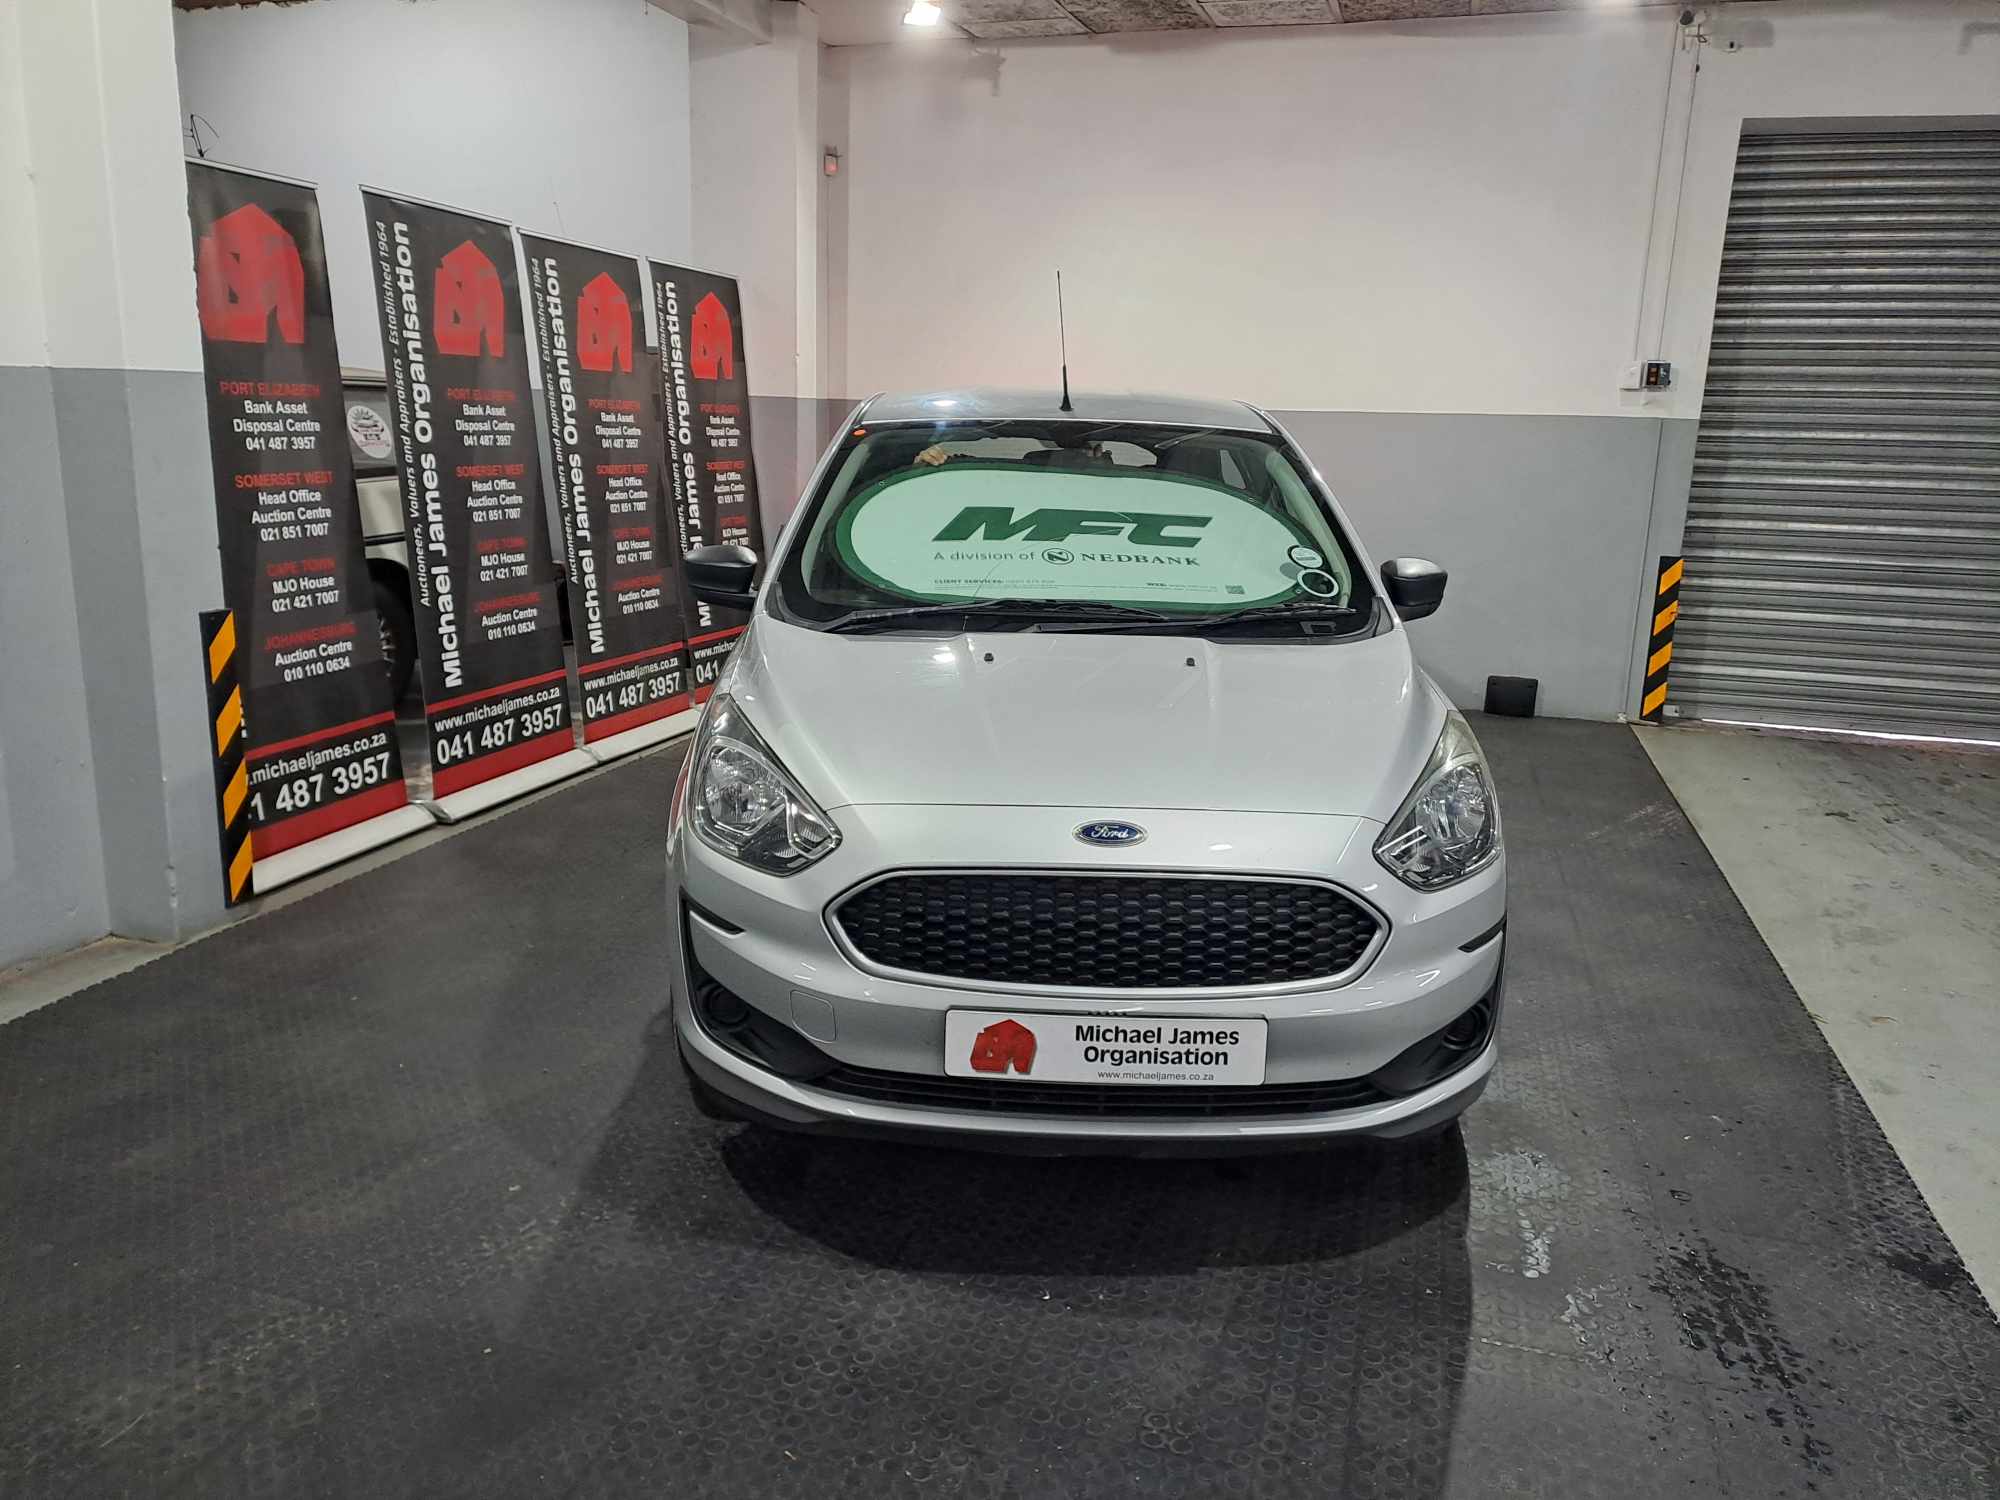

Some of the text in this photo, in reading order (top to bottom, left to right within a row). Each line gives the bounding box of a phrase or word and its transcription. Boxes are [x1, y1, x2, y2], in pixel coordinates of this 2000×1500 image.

[375, 220, 390, 259] 1964
[381, 261, 400, 345] Established
[665, 282, 691, 445] Organisation
[219, 381, 254, 395] PORT
[392, 357, 409, 432] Appraisers
[244, 400, 308, 414] Bank Asset
[463, 404, 507, 416] Bank Asset
[546, 373, 561, 437] Appraisers
[233, 418, 320, 435] Disposal Centre
[455, 419, 491, 433] Disposal
[246, 436, 315, 451] 041 487 3957
[400, 434, 413, 463] and
[554, 439, 564, 463] and
[671, 439, 679, 460] and
[393, 222, 463, 689] Michael James Organisation
[544, 258, 605, 654] Michael James Organisation
[234, 473, 299, 488] SOMERSET
[405, 466, 422, 518] Valuers
[471, 479, 516, 491] Head Office
[558, 465, 569, 508] Valuers
[672, 462, 683, 501] Valuers
[683, 452, 702, 529] James
[258, 489, 321, 505] Head Office
[467, 494, 523, 508] Auction Centre
[252, 506, 332, 524] Auction Centre
[472, 511, 487, 523] 021
[260, 522, 329, 542] 021 851 7007
[678, 504, 690, 557] ctioneers,
[932, 506, 1213, 548] MFC
[500, 553, 526, 564] House
[563, 513, 579, 584] Auctioneers,
[934, 552, 1200, 565] A division of NEDBANK
[413, 522, 431, 607] Auctioneers,
[480, 570, 494, 582] 021
[272, 575, 335, 594] MJO House
[272, 590, 340, 613] 021 421 7007
[481, 606, 538, 627] Auction Centre
[487, 628, 502, 641] 010
[503, 625, 517, 637] 110
[275, 640, 353, 667] Auction Centre
[284, 667, 303, 682] 010
[305, 662, 324, 678] 110
[584, 656, 678, 691] www.michaeljames.co.za
[696, 660, 719, 683] 041
[585, 672, 680, 719] 041 487 3957
[434, 687, 560, 732] www.michaeljames.co.za
[436, 703, 562, 765] 041 487 3957
[250, 732, 387, 785] .michaeljames.co.za
[275, 773, 324, 812] 487
[332, 752, 390, 794] 3957
[1091, 825, 1128, 838] Ford
[1075, 1025, 1239, 1045] Michael James
[1084, 1047, 1228, 1067] Organisation
[1097, 1070, 1214, 1081] www.michaeljames.co.za
